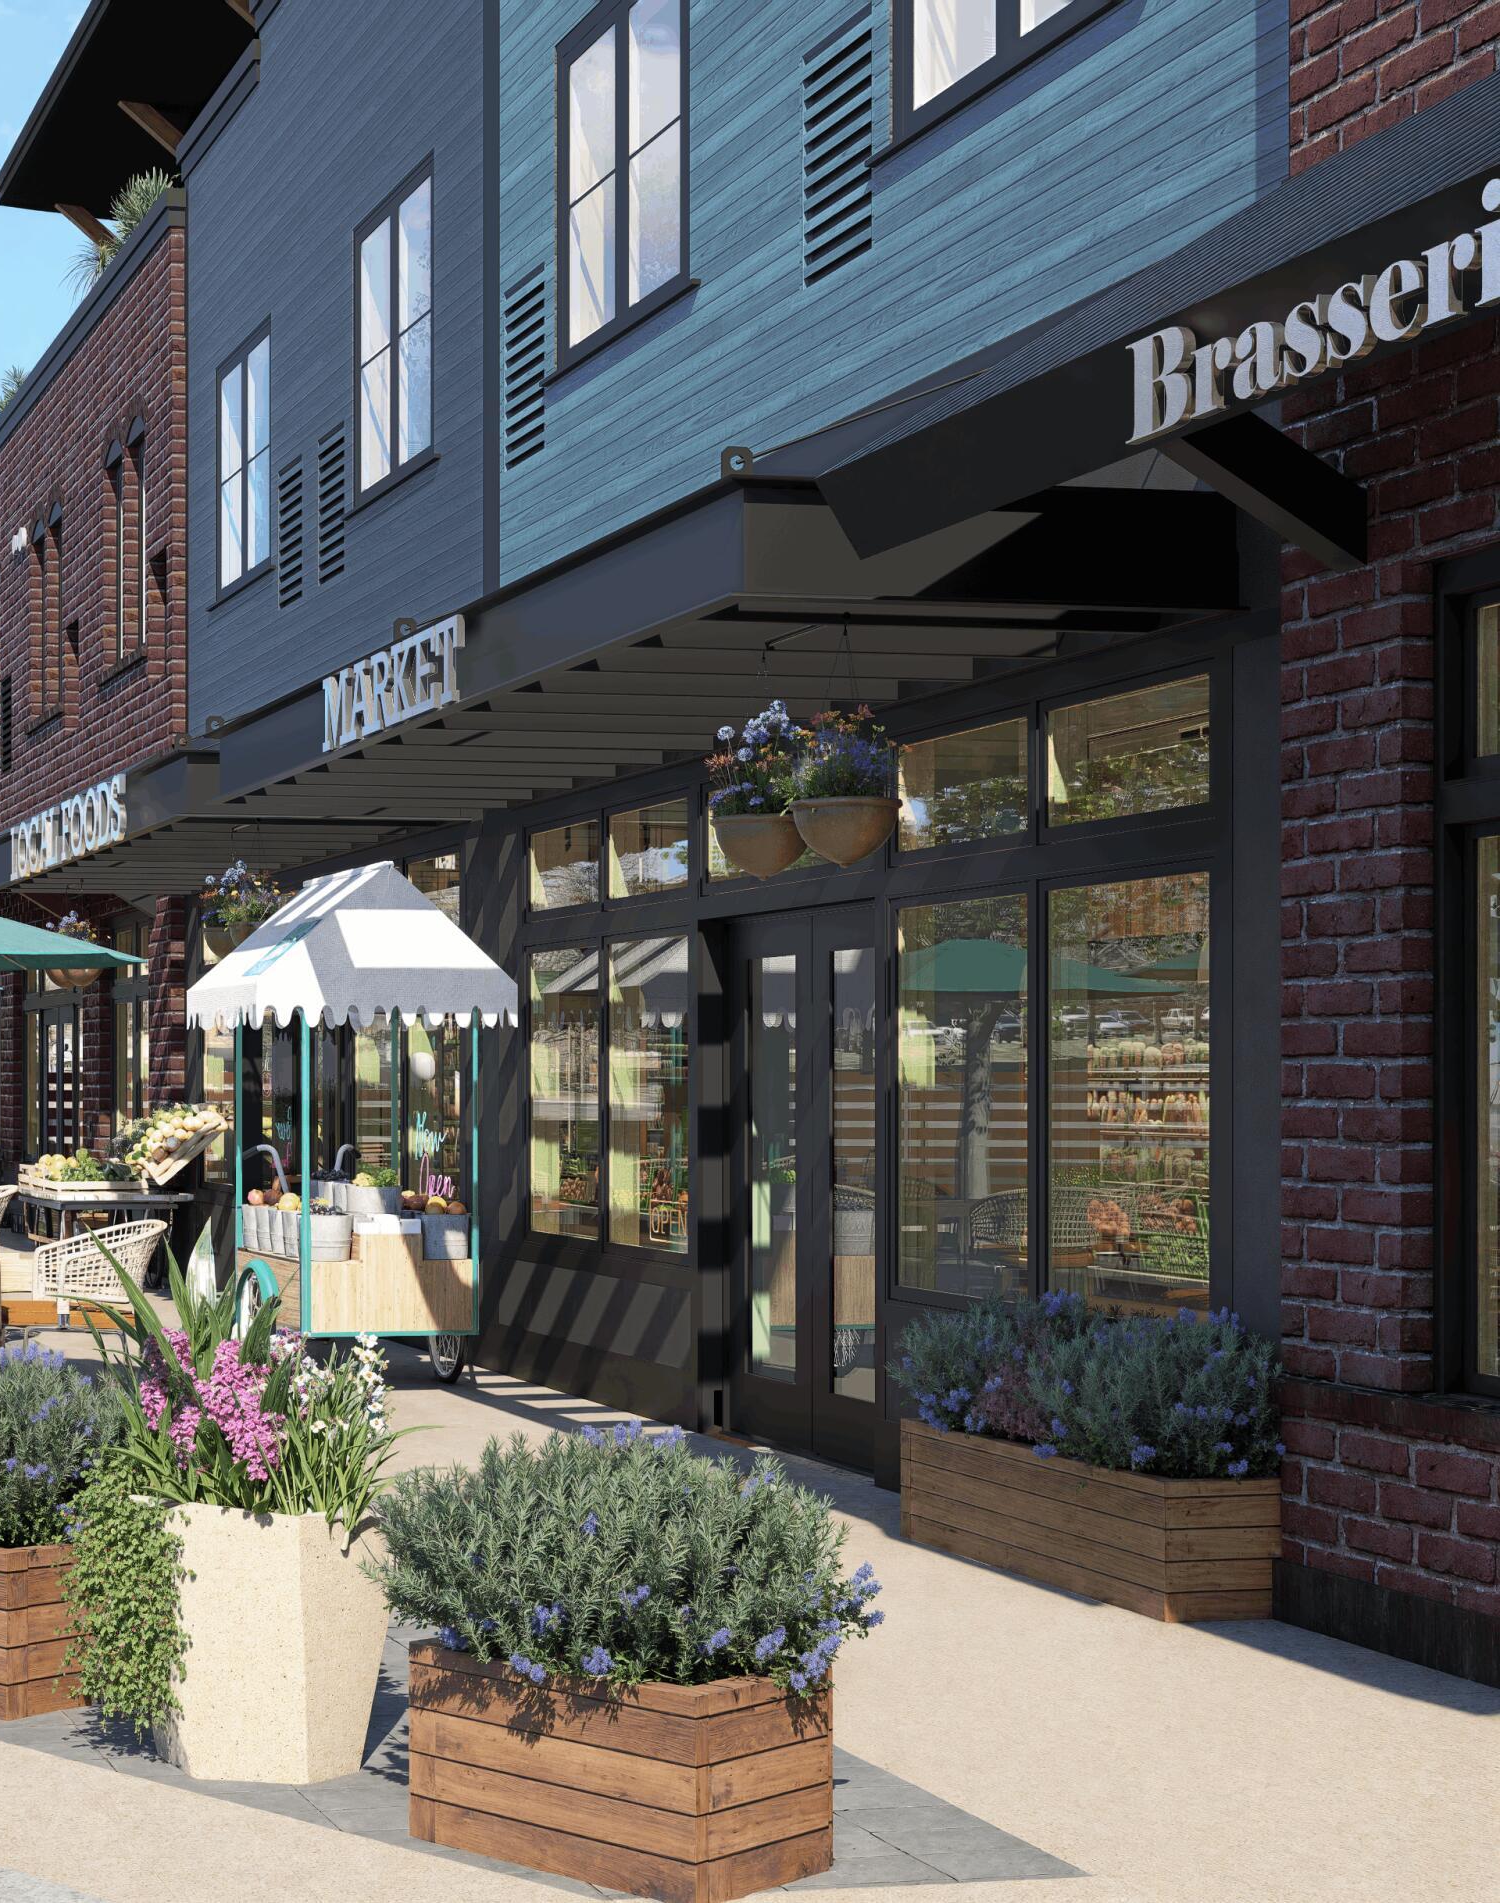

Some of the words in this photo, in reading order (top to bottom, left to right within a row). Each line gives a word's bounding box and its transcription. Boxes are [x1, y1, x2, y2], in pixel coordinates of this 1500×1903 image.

[322, 614, 466, 752] MARKET
[61, 774, 127, 861] FOODS
[651, 1207, 688, 1237] OPEN
